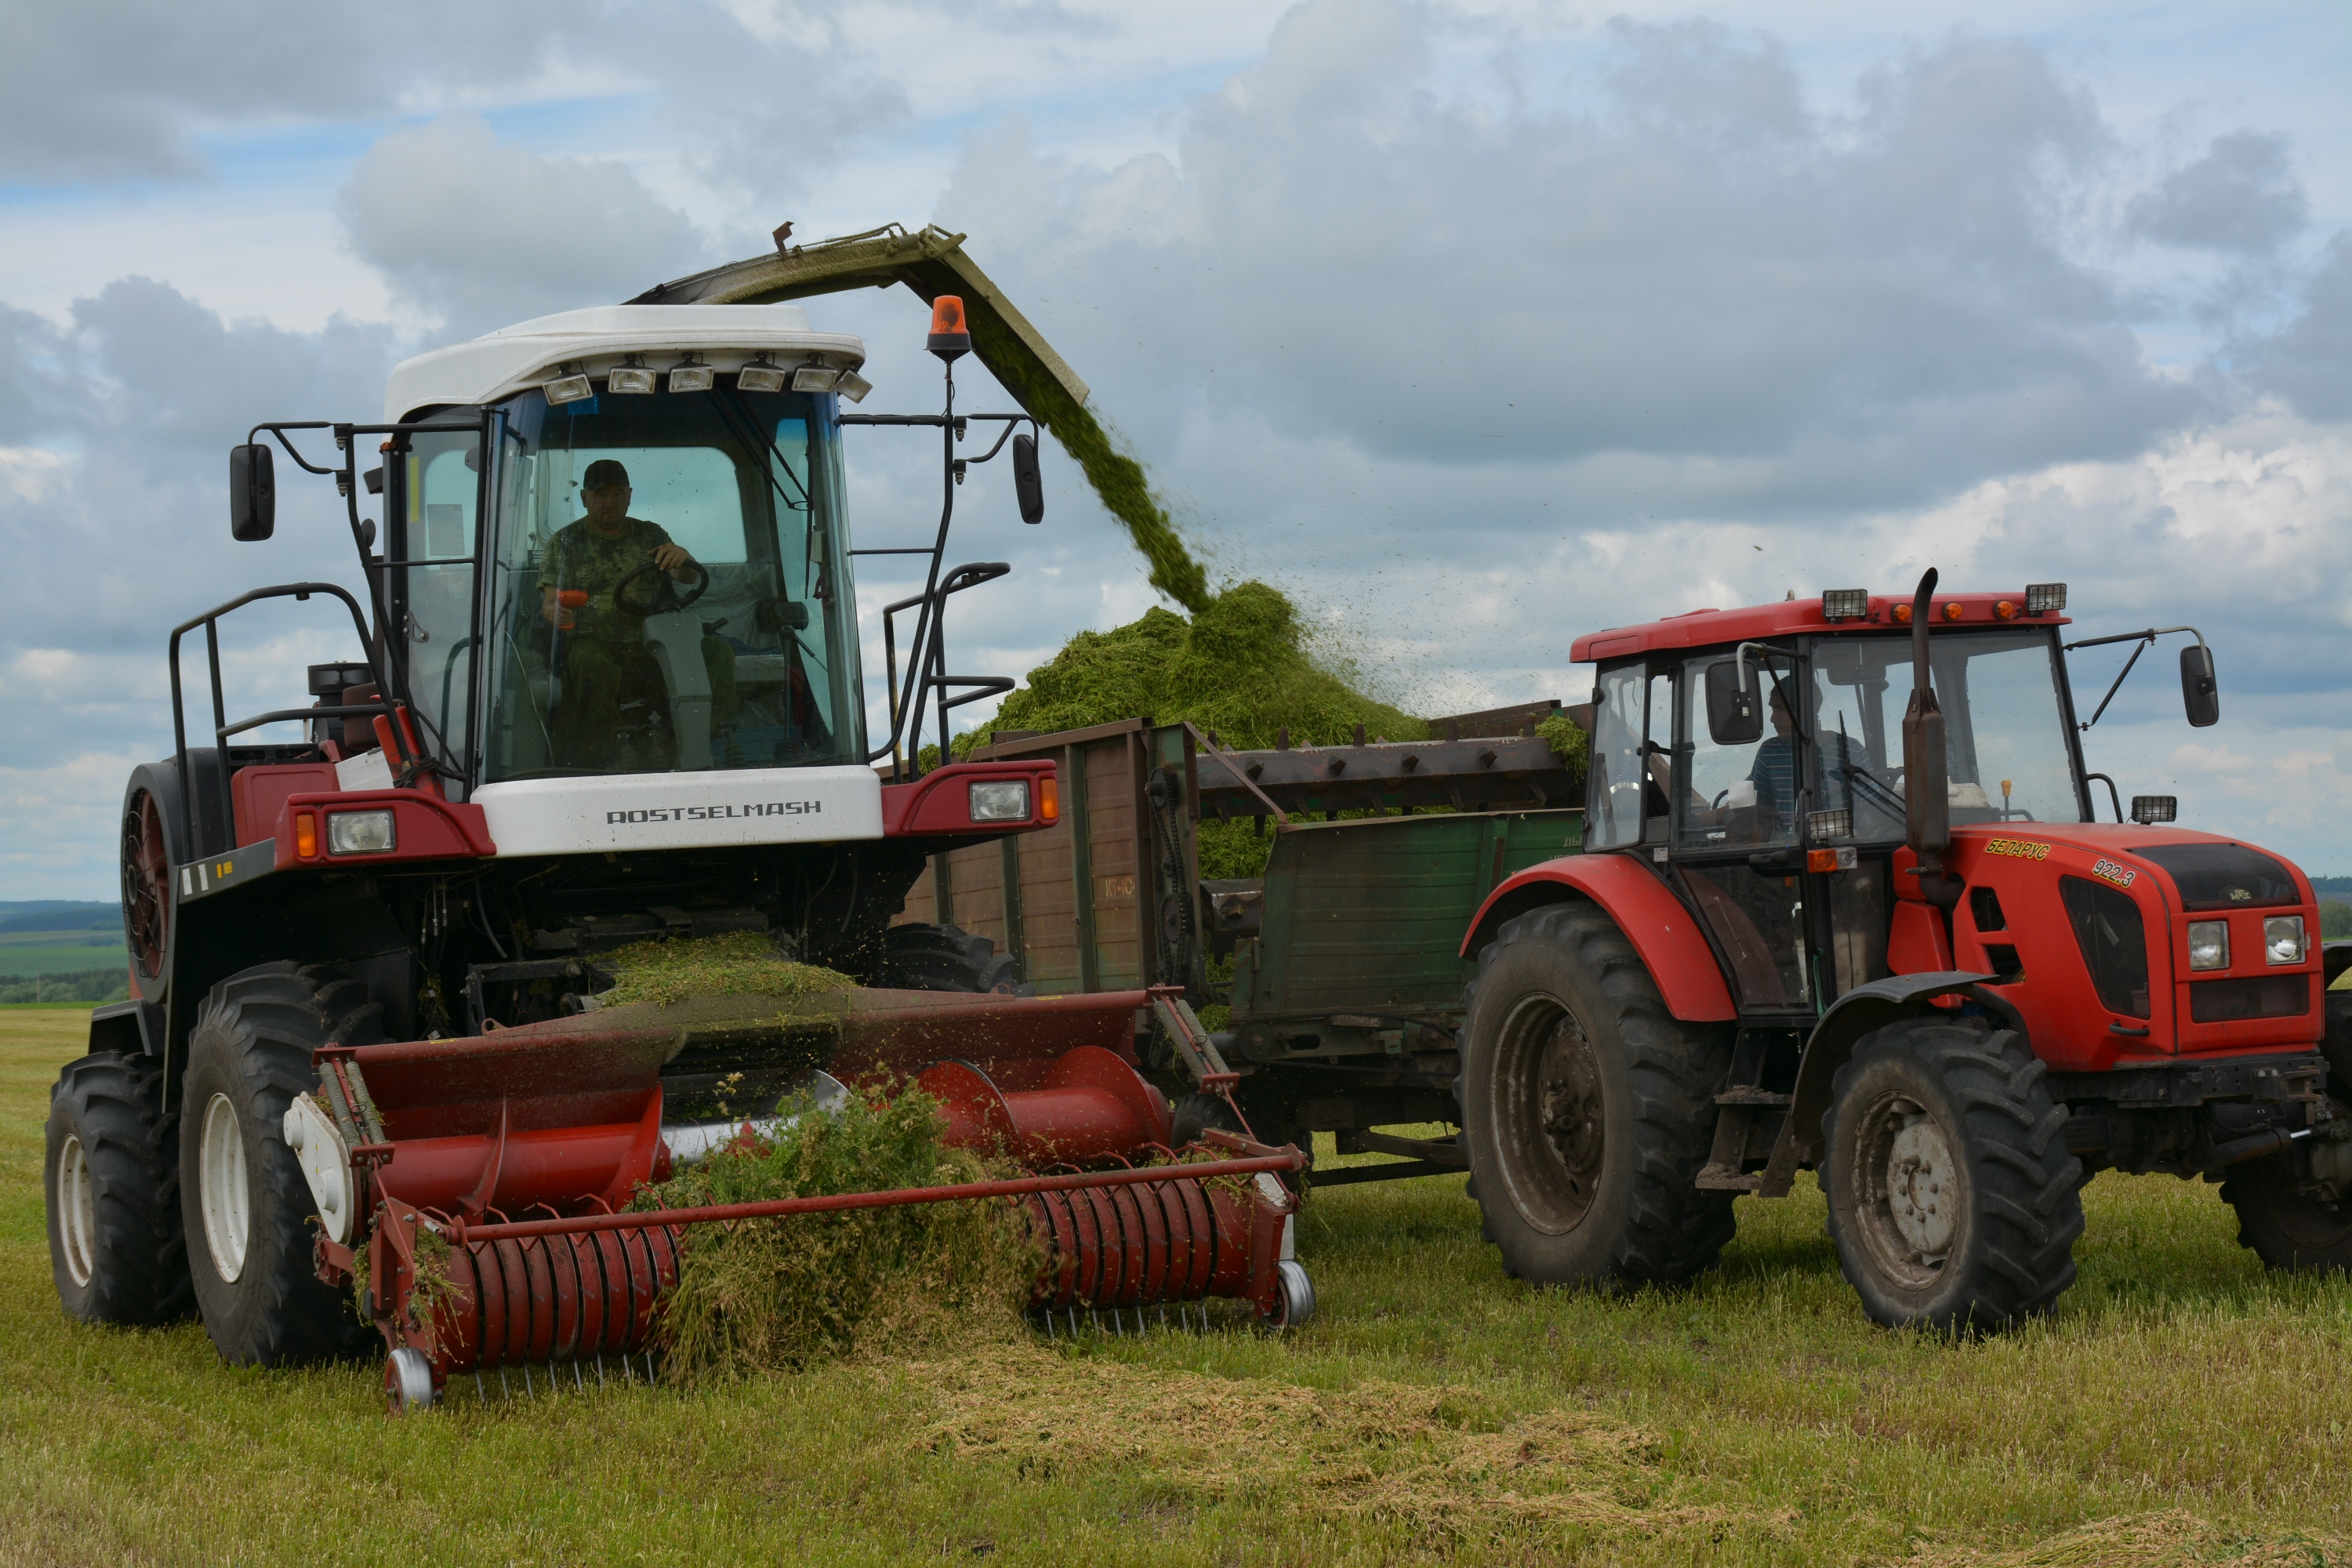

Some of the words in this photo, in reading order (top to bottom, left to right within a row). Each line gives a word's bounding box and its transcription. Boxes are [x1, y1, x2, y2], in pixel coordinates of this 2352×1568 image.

[606, 800, 822, 824] ROSTSELMASH
[1985, 838, 2051, 861] БЕЛАРУС
[2092, 858, 2136, 888] 922.3
